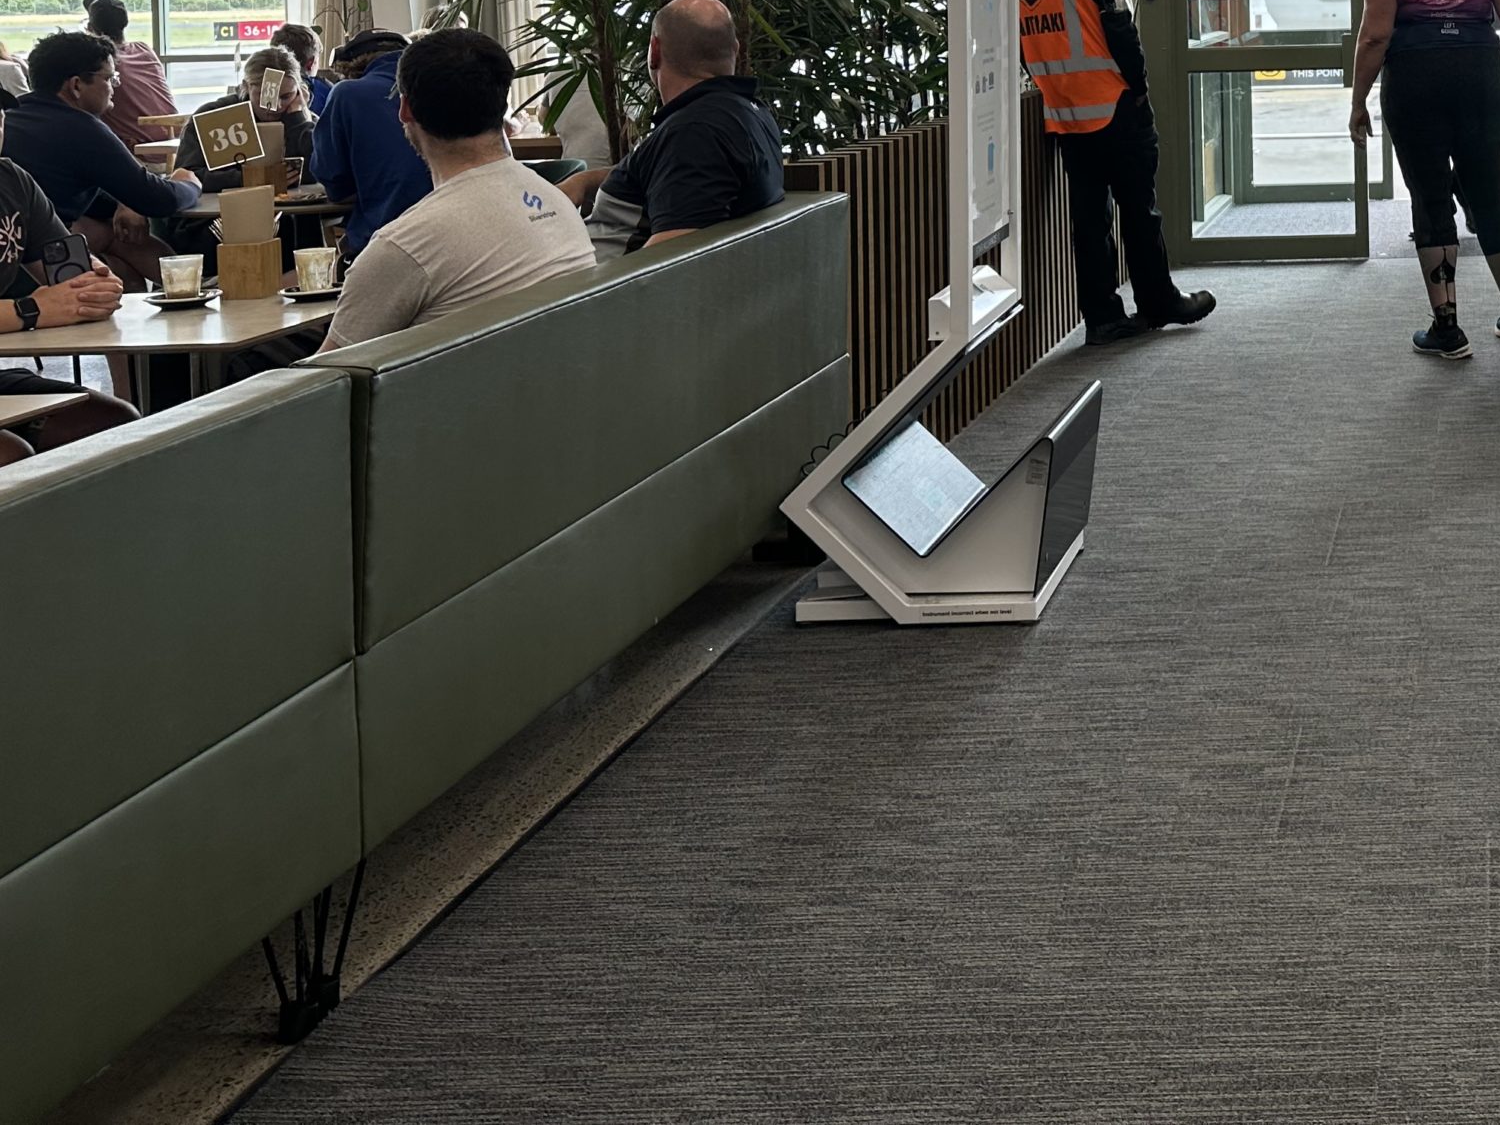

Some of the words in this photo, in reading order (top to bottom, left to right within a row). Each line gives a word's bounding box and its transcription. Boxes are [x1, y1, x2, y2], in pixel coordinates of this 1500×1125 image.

[220, 26, 235, 37] C1
[1291, 69, 1314, 78] THIS
[263, 81, 278, 99] 35
[208, 122, 249, 152] 36
